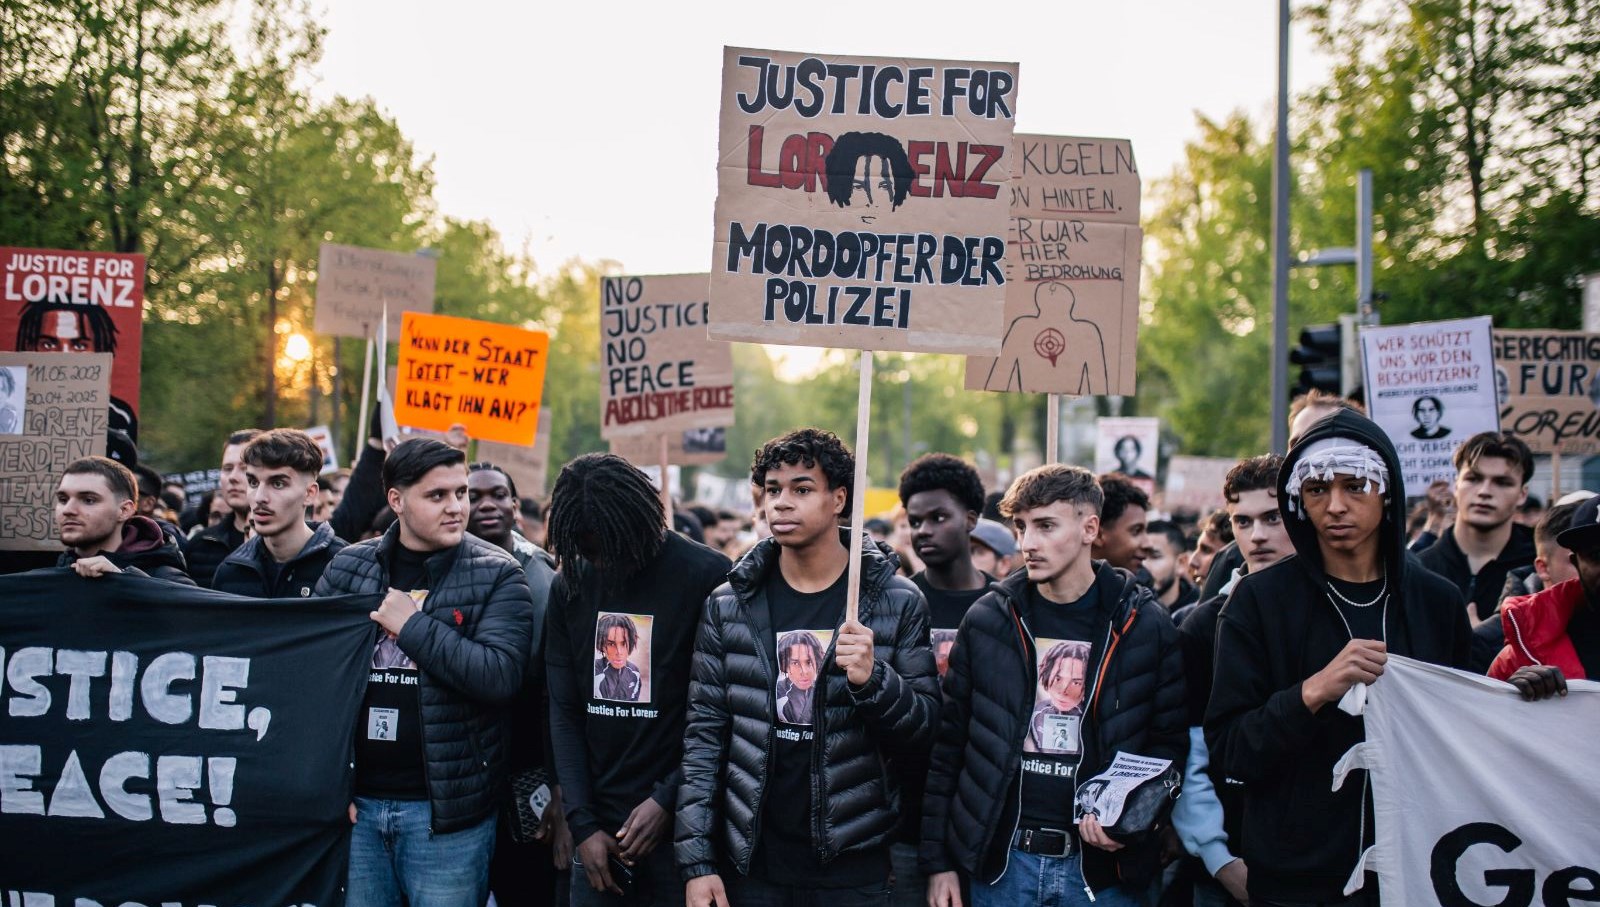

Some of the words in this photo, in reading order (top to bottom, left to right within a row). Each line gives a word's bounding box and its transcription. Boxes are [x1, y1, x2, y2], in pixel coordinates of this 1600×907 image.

[736, 55, 935, 119] JUSTICE
[941, 67, 1014, 119] FOR
[1022, 141, 1137, 175] KUGELN.
[1042, 187, 1122, 211] HINTEN.
[1041, 220, 1088, 242] WAR
[6, 253, 87, 275] JUSTICE
[94, 258, 134, 277] FOR
[727, 221, 938, 284] MORDOPFER
[940, 234, 1006, 287] DER
[1020, 243, 1070, 261] HIER
[1026, 264, 1122, 281] BEDROHUNG
[5, 273, 135, 308] LORENZ
[605, 276, 643, 306] NO
[764, 278, 912, 329] POLIZEI
[444, 338, 470, 355] DER
[476, 337, 539, 369] STAAT
[607, 337, 646, 366] NO
[1376, 335, 1405, 352] WER
[1380, 354, 1406, 370] UNS
[1411, 351, 1438, 367] VOR
[1441, 349, 1472, 365] DEN
[473, 366, 510, 386] WER
[609, 361, 695, 396] PEACE
[406, 389, 453, 412] KLAGT
[458, 395, 485, 414] IHN
[693, 385, 735, 412] POLICE
[23, 406, 108, 437] LORENZ
[1501, 405, 1600, 445] OREN
[385, 672, 399, 684] For
[0, 646, 272, 741] STICE,
[587, 702, 614, 716] Justice
[615, 706, 630, 717] For
[631, 707, 659, 718] Lorenz
[776, 728, 800, 742] ustice
[1054, 762, 1073, 776] For
[0, 744, 237, 828] EACE!
